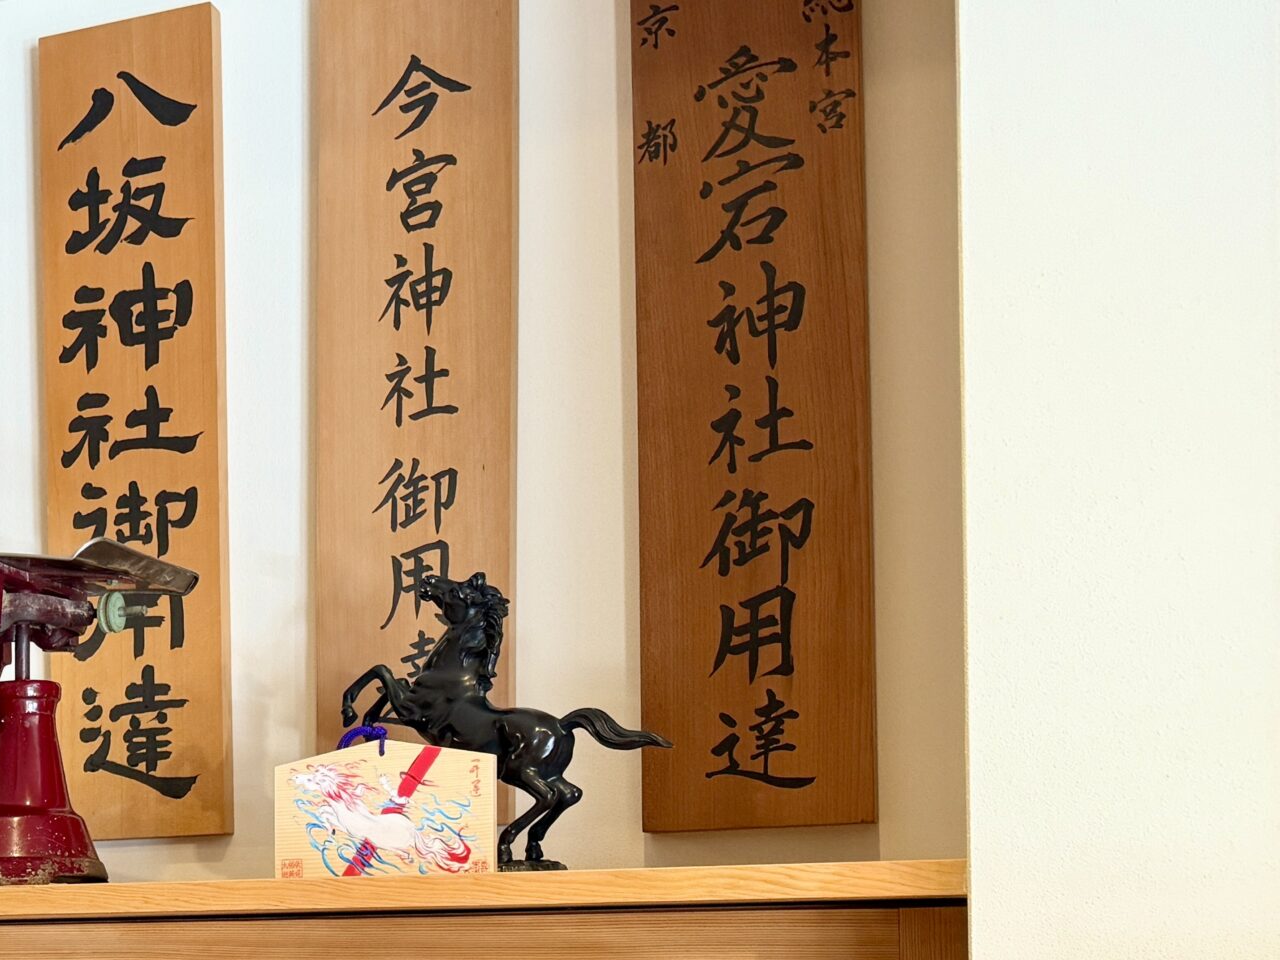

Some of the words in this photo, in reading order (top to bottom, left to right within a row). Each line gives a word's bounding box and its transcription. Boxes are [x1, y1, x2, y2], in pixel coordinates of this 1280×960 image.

[692, 44, 817, 789] 愛宕神社御用達
